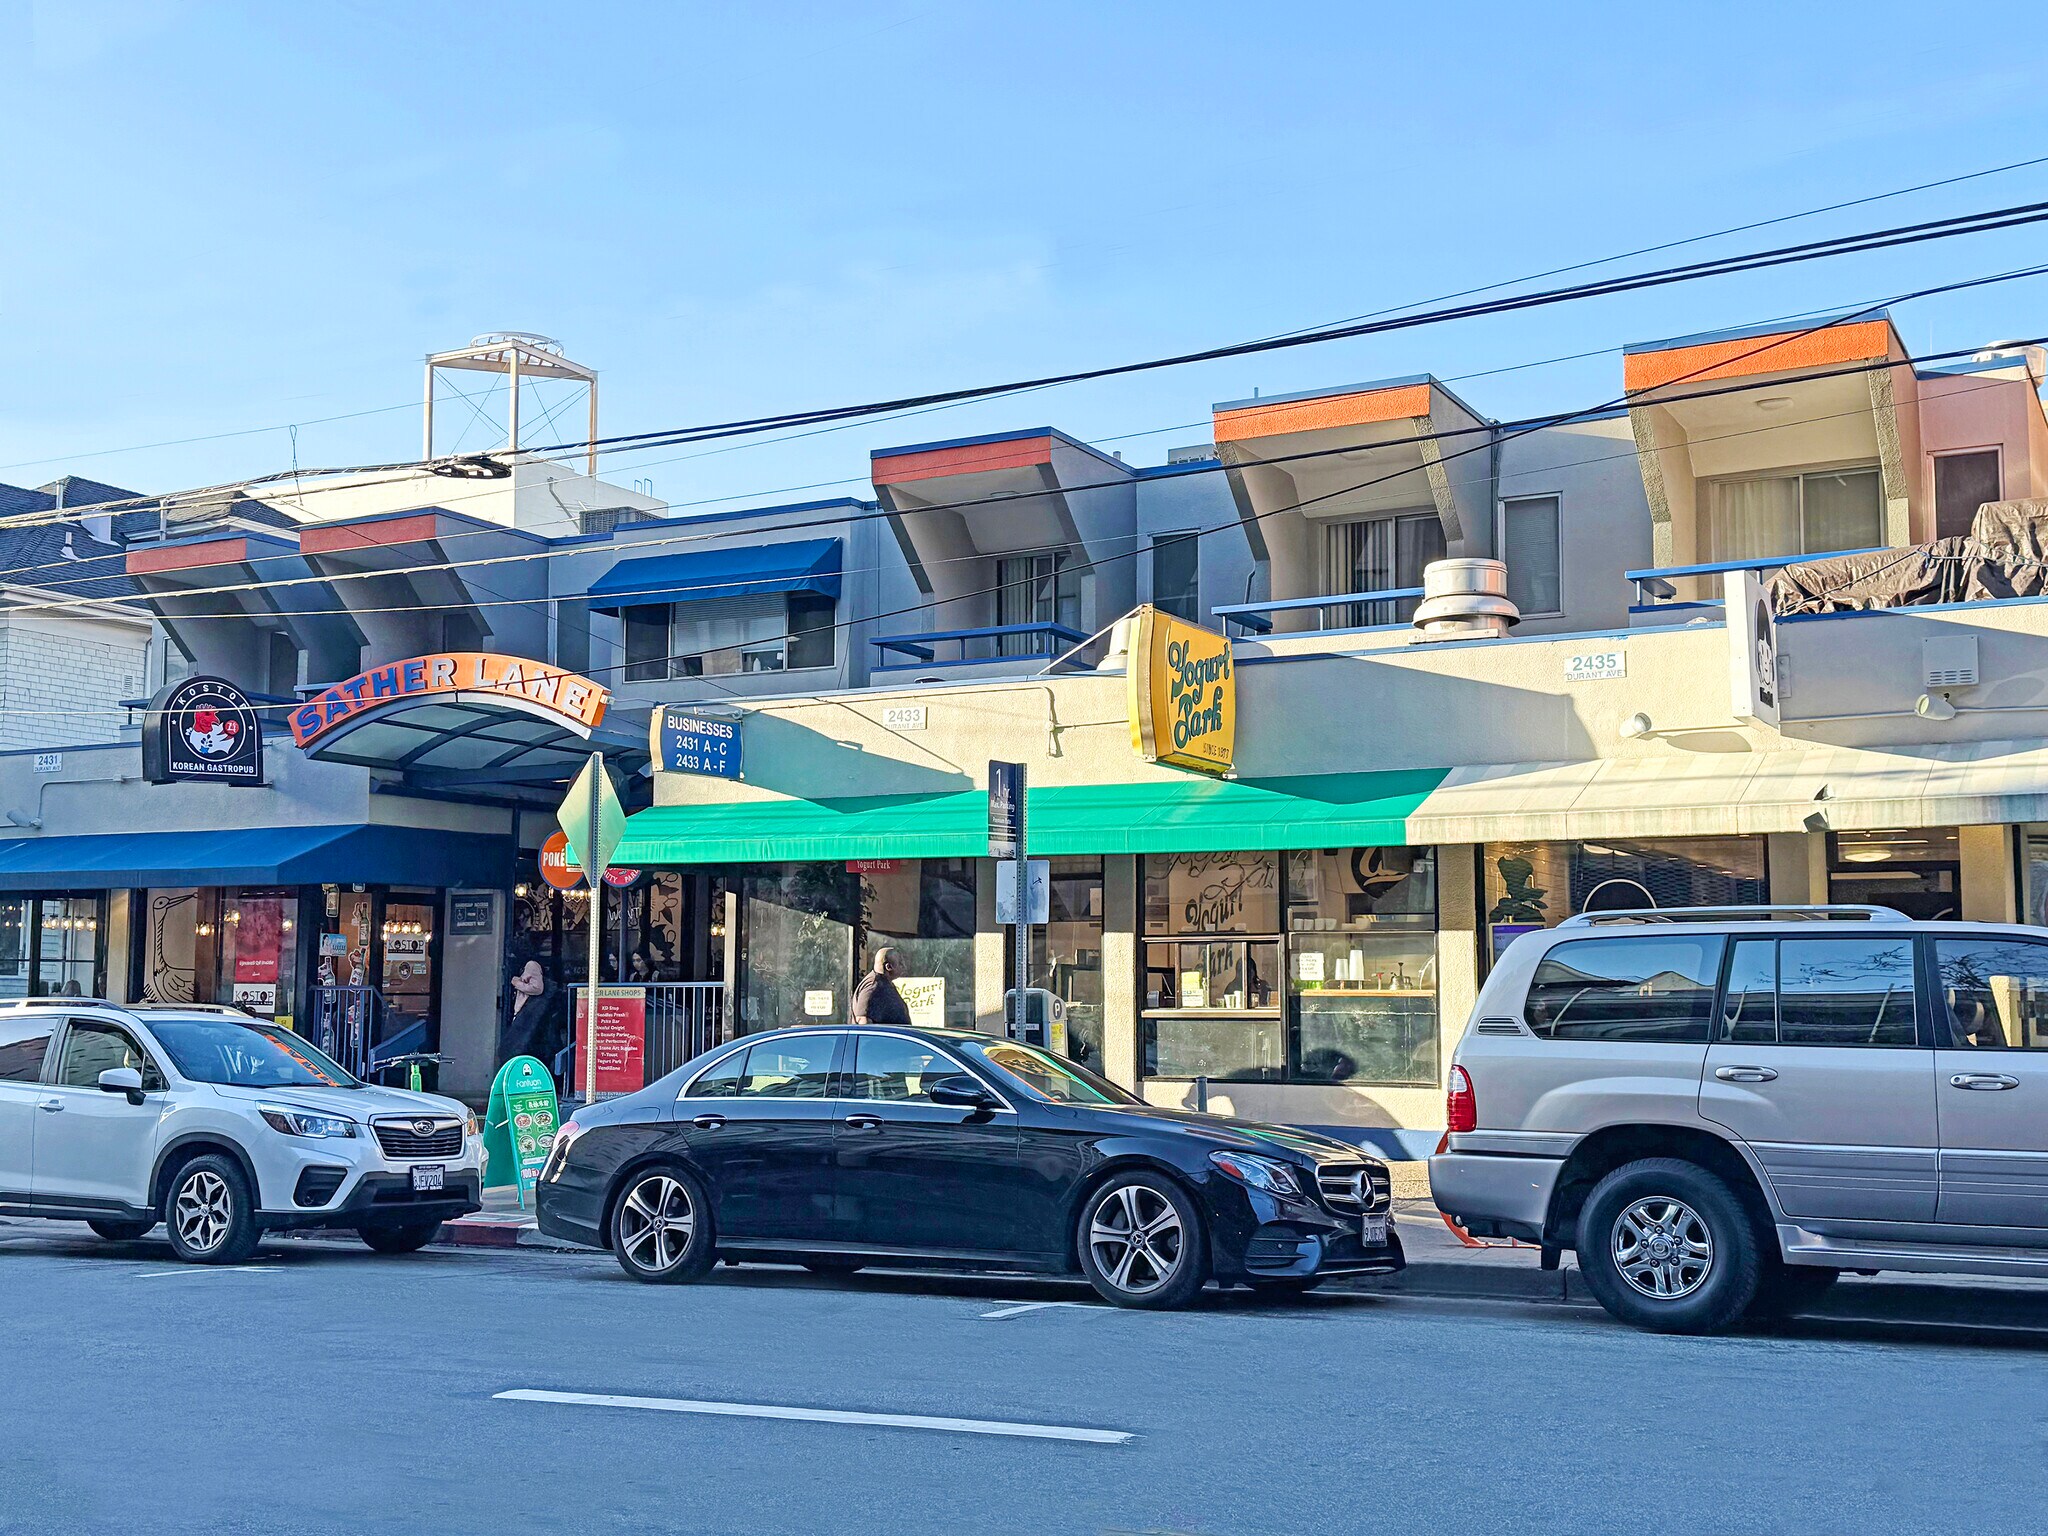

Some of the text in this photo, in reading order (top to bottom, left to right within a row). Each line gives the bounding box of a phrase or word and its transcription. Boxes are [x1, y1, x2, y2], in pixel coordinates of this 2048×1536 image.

[1572, 653, 1617, 671] 2435
[1168, 640, 1230, 705] Yogurt
[1566, 671, 1602, 680] DURANT
[177, 684, 248, 709] KOSTOP
[296, 658, 591, 739] SATHER LANE
[888, 709, 920, 722] 2433
[1173, 686, 1224, 749] Park
[667, 715, 733, 739] BUSINESSES
[676, 735, 699, 751] 2431
[703, 740, 712, 754] A
[719, 742, 727, 755] C
[38, 755, 58, 766] 2431
[172, 761, 254, 773] KOREAN GASTROPUB
[676, 753, 699, 769] 2433
[703, 757, 712, 771] A
[719, 760, 726, 773] F
[995, 768, 1001, 797] 1
[542, 848, 565, 867] POKÉ
[856, 859, 891, 871] Yogurt Park
[896, 979, 943, 999] Yogurt
[1054, 1002, 1061, 1017] P
